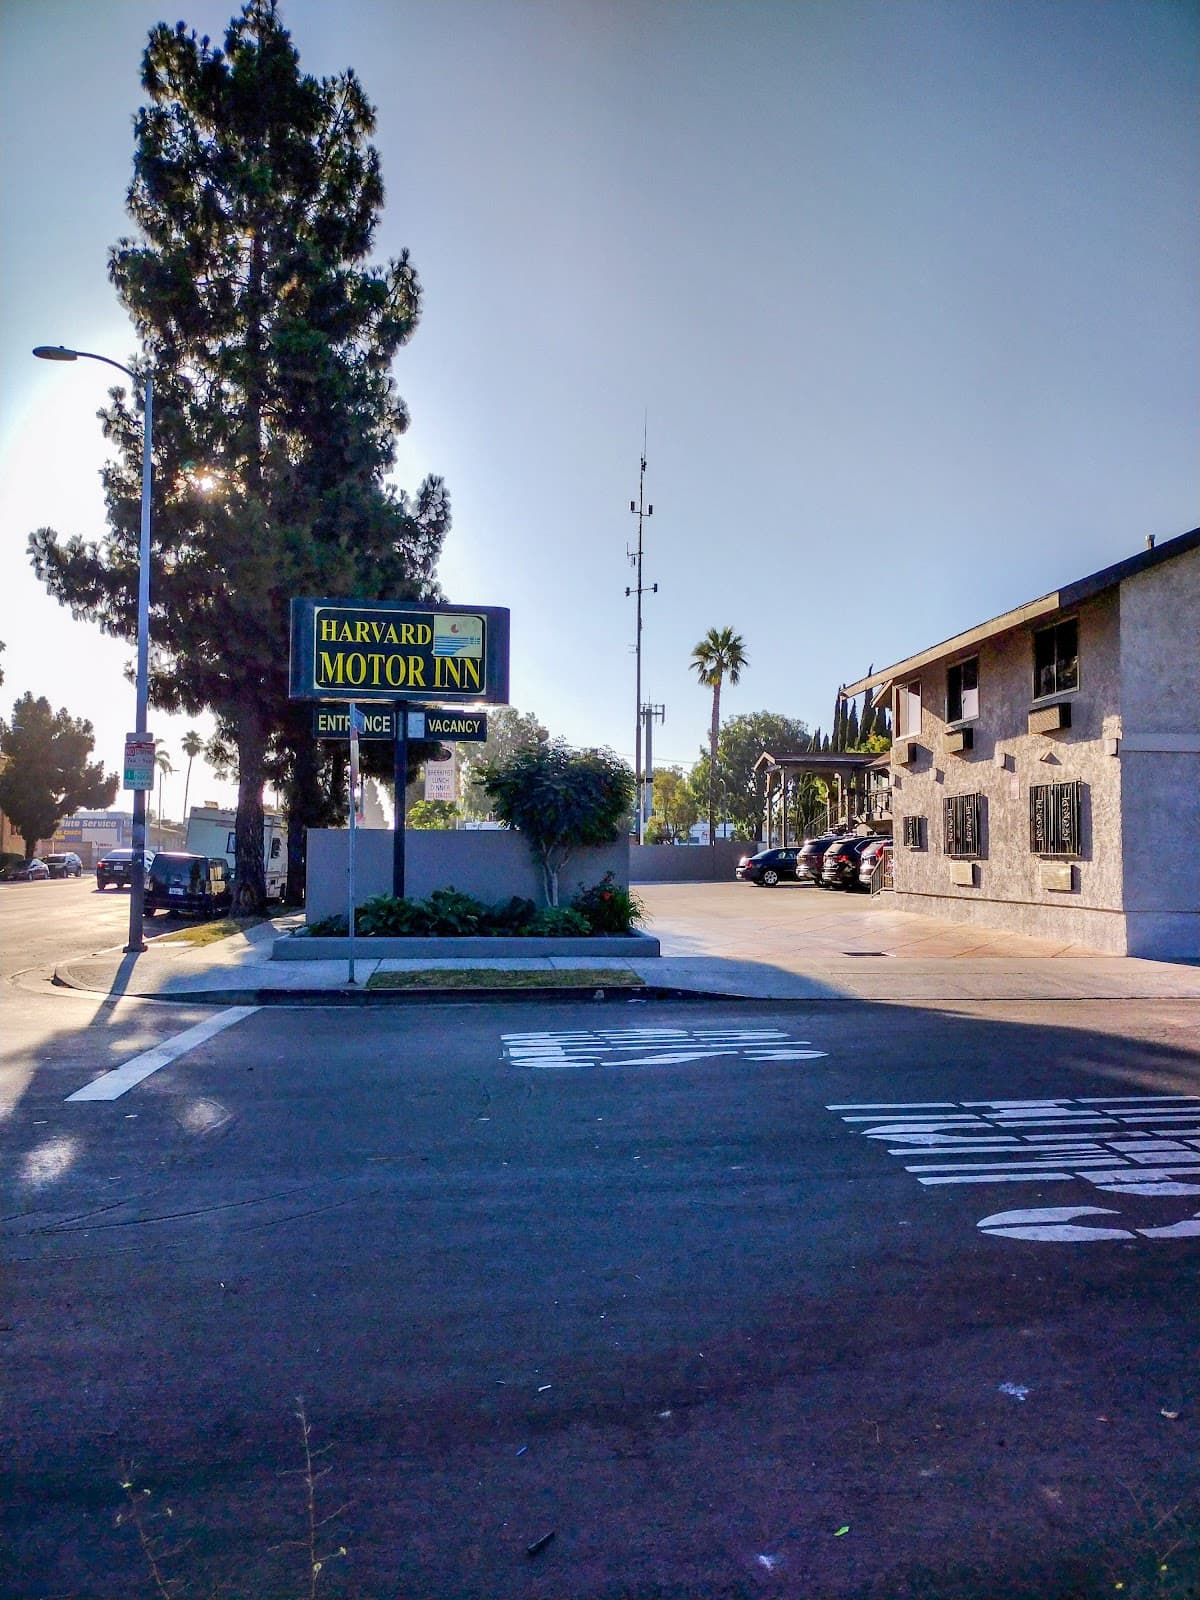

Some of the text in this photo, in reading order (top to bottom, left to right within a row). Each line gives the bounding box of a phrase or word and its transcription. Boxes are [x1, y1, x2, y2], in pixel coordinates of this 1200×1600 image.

[320, 619, 432, 645] HARVARD
[319, 651, 482, 689] MOTOR INN
[318, 713, 391, 733] ENTRNCE
[428, 719, 481, 734] VACANCY
[82, 820, 117, 828] Service
[500, 1028, 830, 1068] STOP
